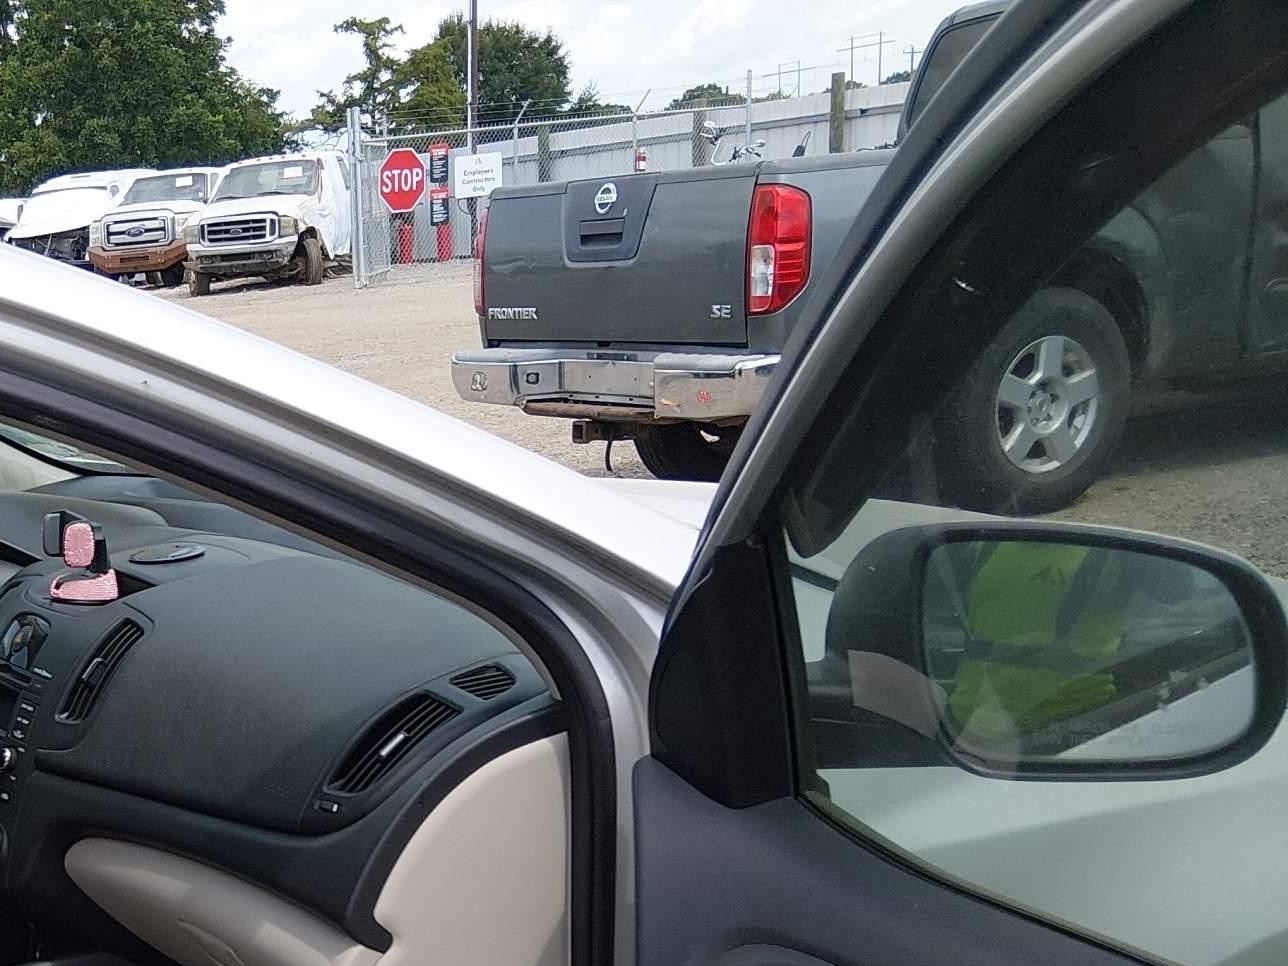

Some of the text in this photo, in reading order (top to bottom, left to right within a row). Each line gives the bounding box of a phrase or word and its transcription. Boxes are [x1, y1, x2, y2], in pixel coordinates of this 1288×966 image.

[382, 168, 422, 193] STOP
[488, 307, 538, 320] FRONTIER
[710, 304, 731, 319] SE
